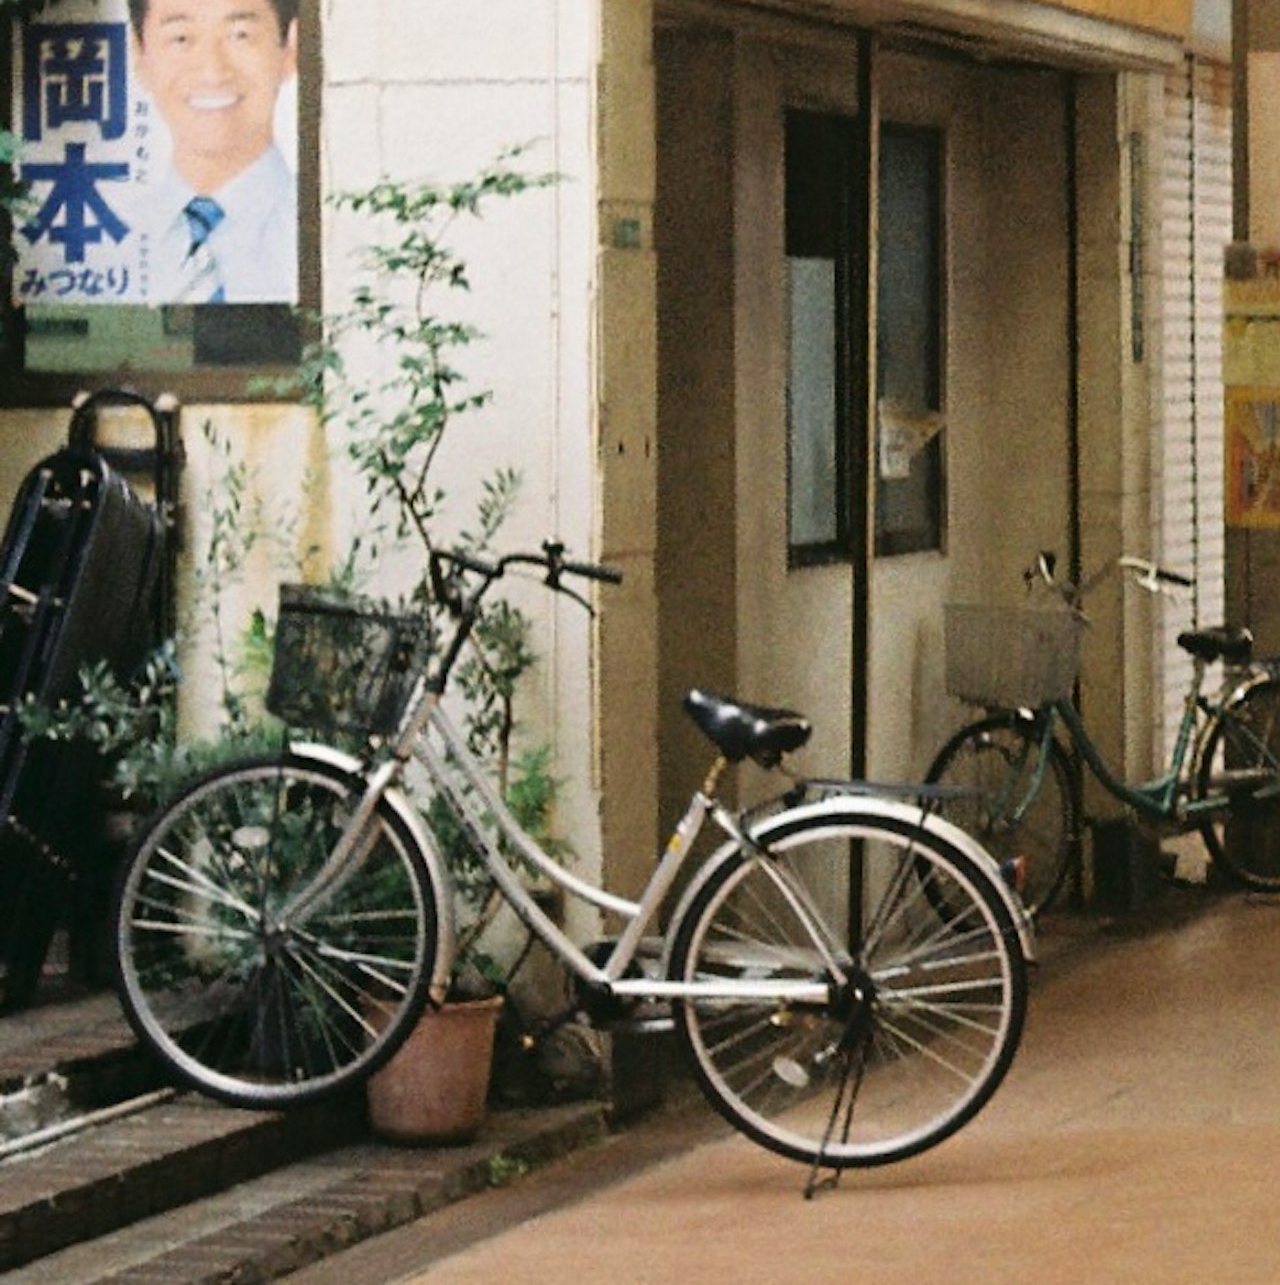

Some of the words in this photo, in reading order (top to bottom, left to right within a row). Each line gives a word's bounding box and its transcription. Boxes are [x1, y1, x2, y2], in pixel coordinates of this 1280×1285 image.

[20, 23, 130, 263] 岡本
[19, 269, 129, 295] みつなり
